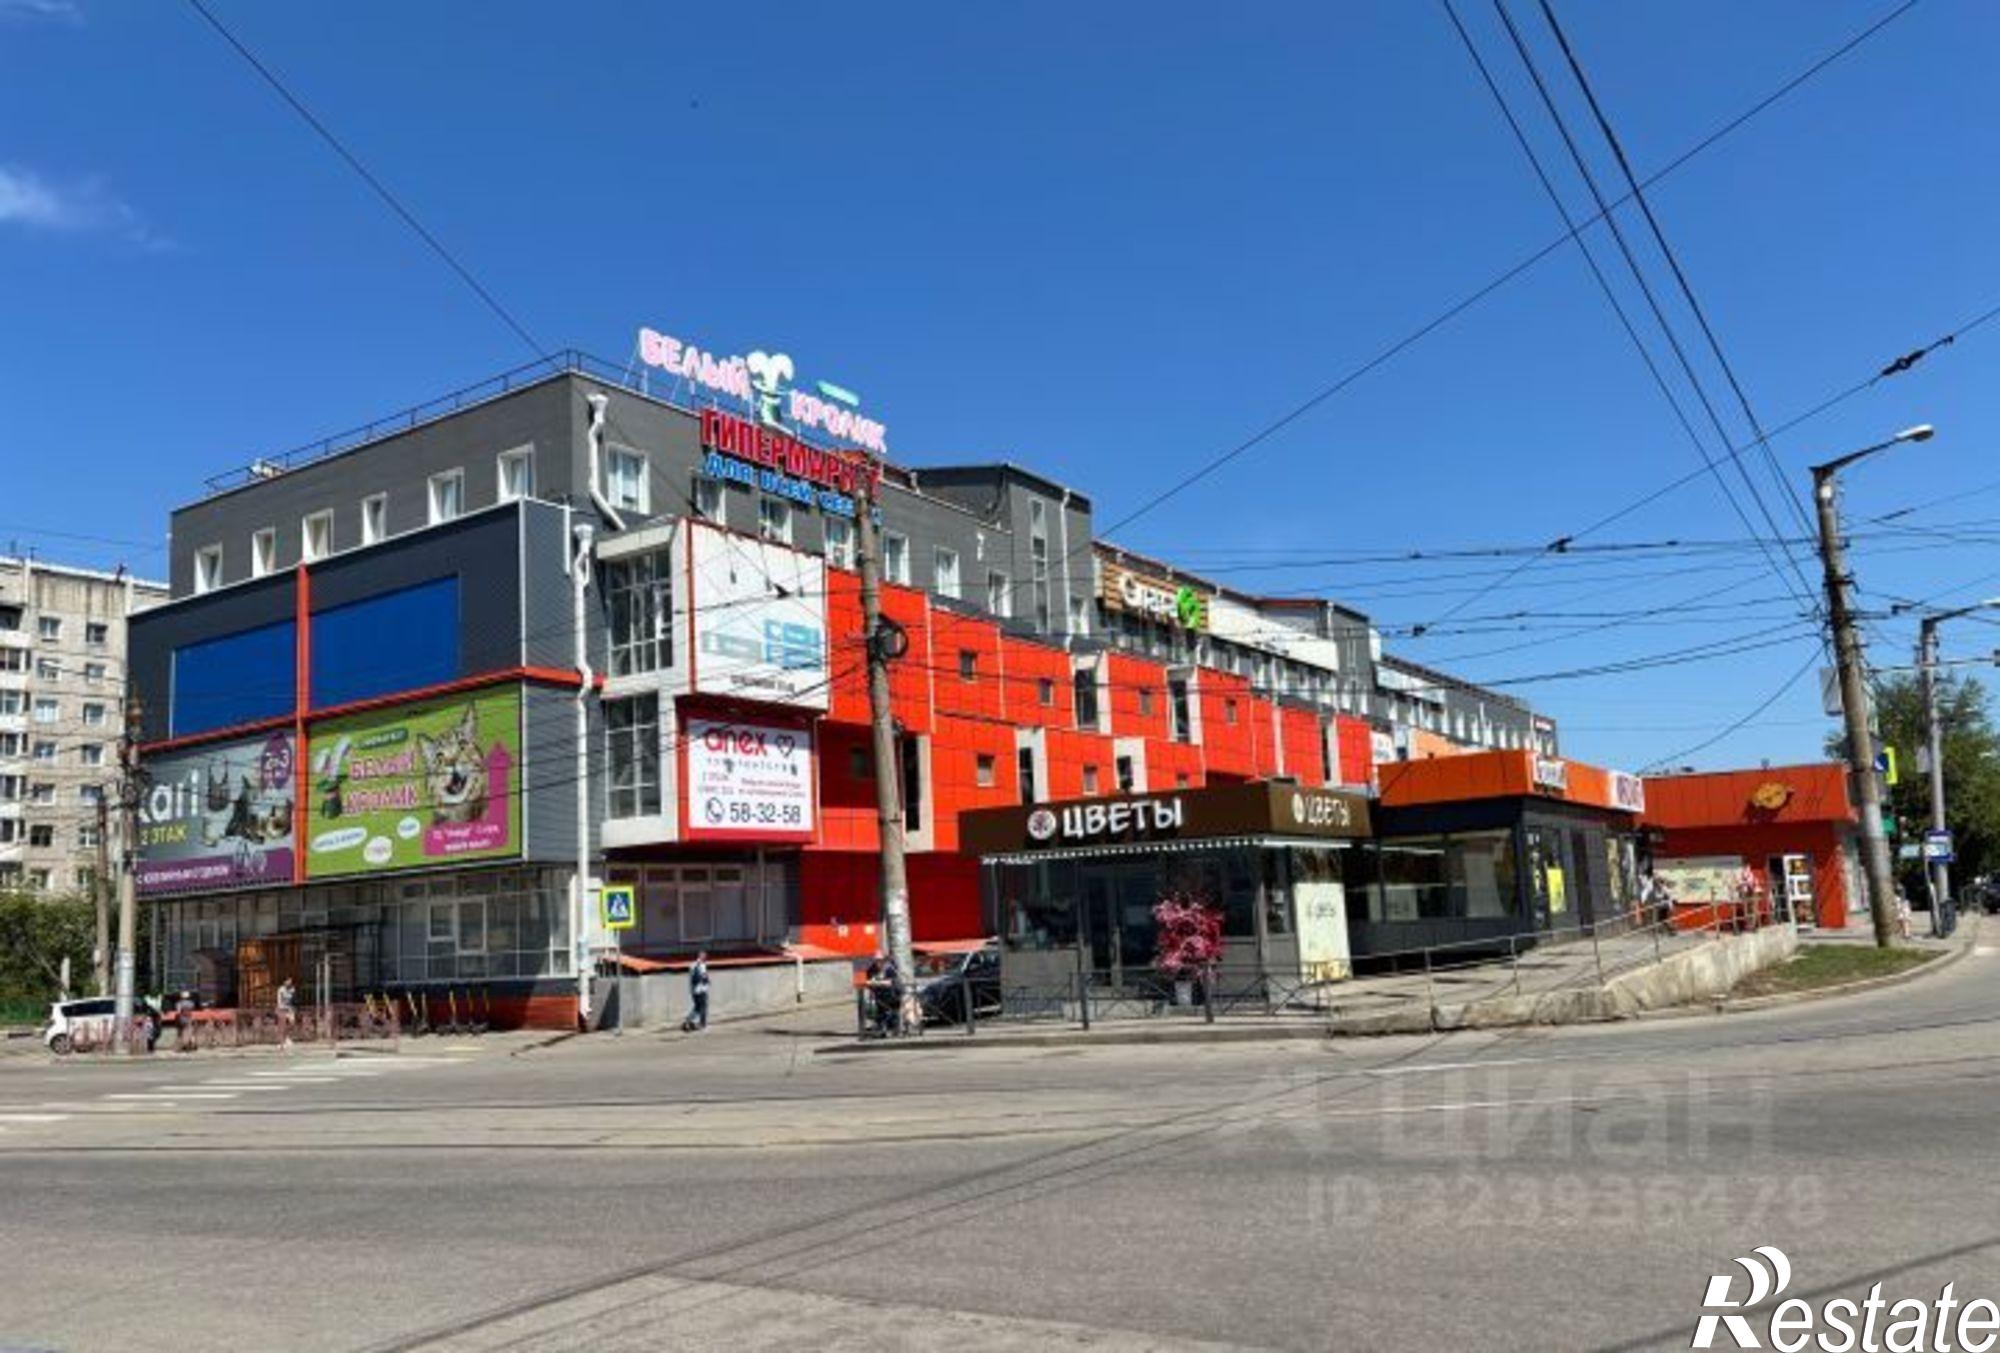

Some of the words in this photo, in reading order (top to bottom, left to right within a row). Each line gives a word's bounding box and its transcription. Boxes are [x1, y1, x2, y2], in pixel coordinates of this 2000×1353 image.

[639, 327, 750, 400] БЕЛЫЙ
[790, 389, 888, 454] КРОЛИК
[701, 408, 882, 501] ГИПЕРМАРКТ
[704, 727, 768, 757] anex
[729, 802, 801, 823] 58-32-58
[1063, 797, 1183, 839] ЦВЕТЫ
[1305, 795, 1350, 827] ЦВЕТЫ
